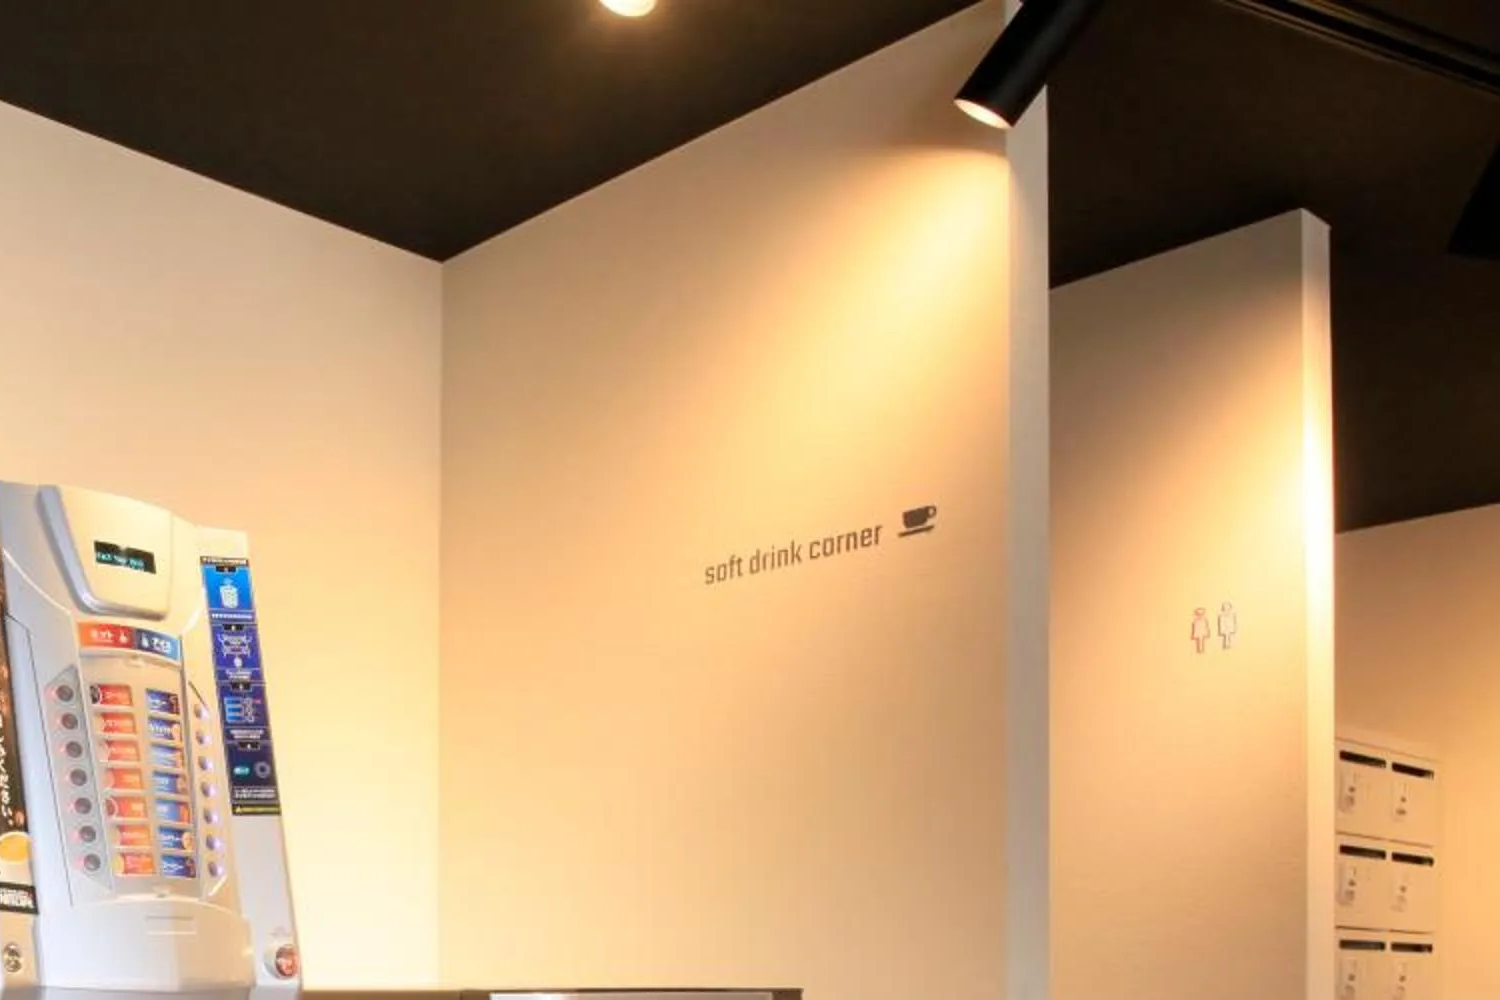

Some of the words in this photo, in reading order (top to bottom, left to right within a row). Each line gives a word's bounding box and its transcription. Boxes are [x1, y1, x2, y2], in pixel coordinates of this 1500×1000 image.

[704, 554, 743, 585] soft
[749, 540, 803, 575] drink
[809, 524, 883, 560] corner
